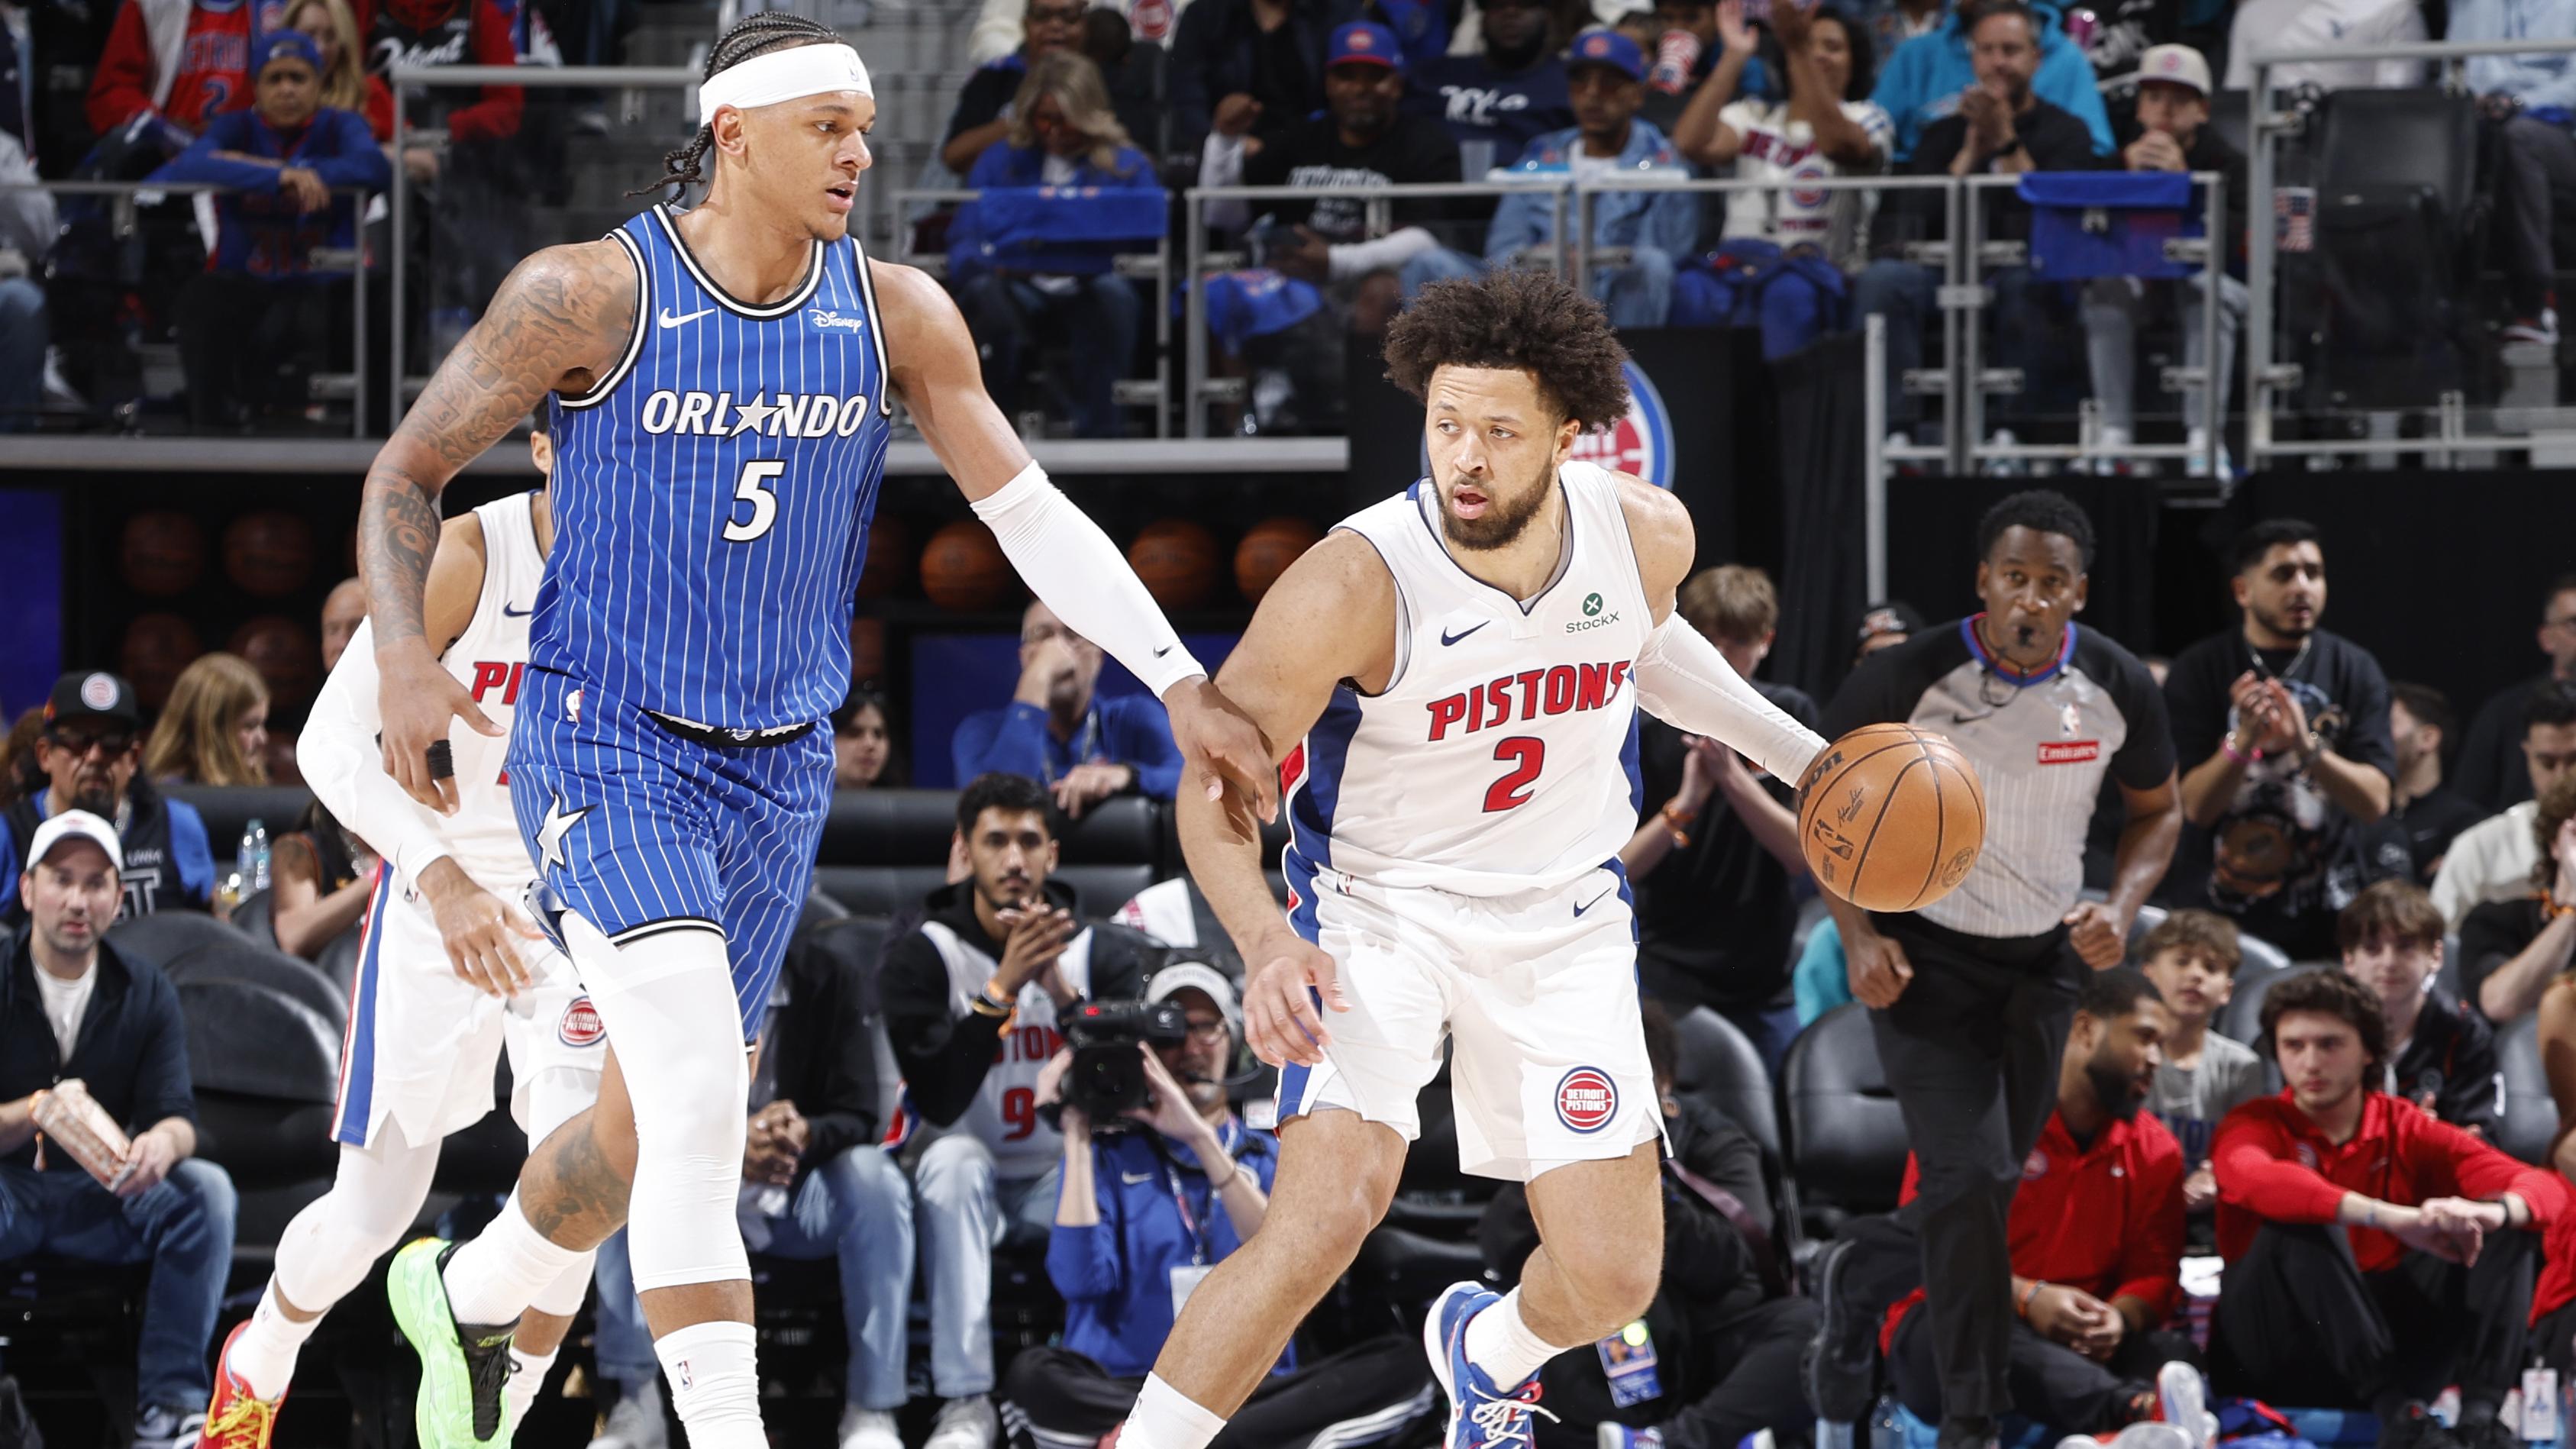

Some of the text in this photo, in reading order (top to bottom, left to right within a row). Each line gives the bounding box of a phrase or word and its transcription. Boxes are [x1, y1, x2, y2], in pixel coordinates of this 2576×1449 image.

[808, 308, 862, 334] Disney
[722, 460, 787, 542] 5
[1565, 610, 1620, 634] StockX
[1426, 660, 1631, 741] PISTONS
[2039, 746, 2097, 761] Emirates
[1482, 735, 1545, 813] 2
[1565, 1088, 1606, 1100] DETROIT
[1565, 1099, 1606, 1112] PISTONS
[1002, 1086, 1035, 1141] 9
